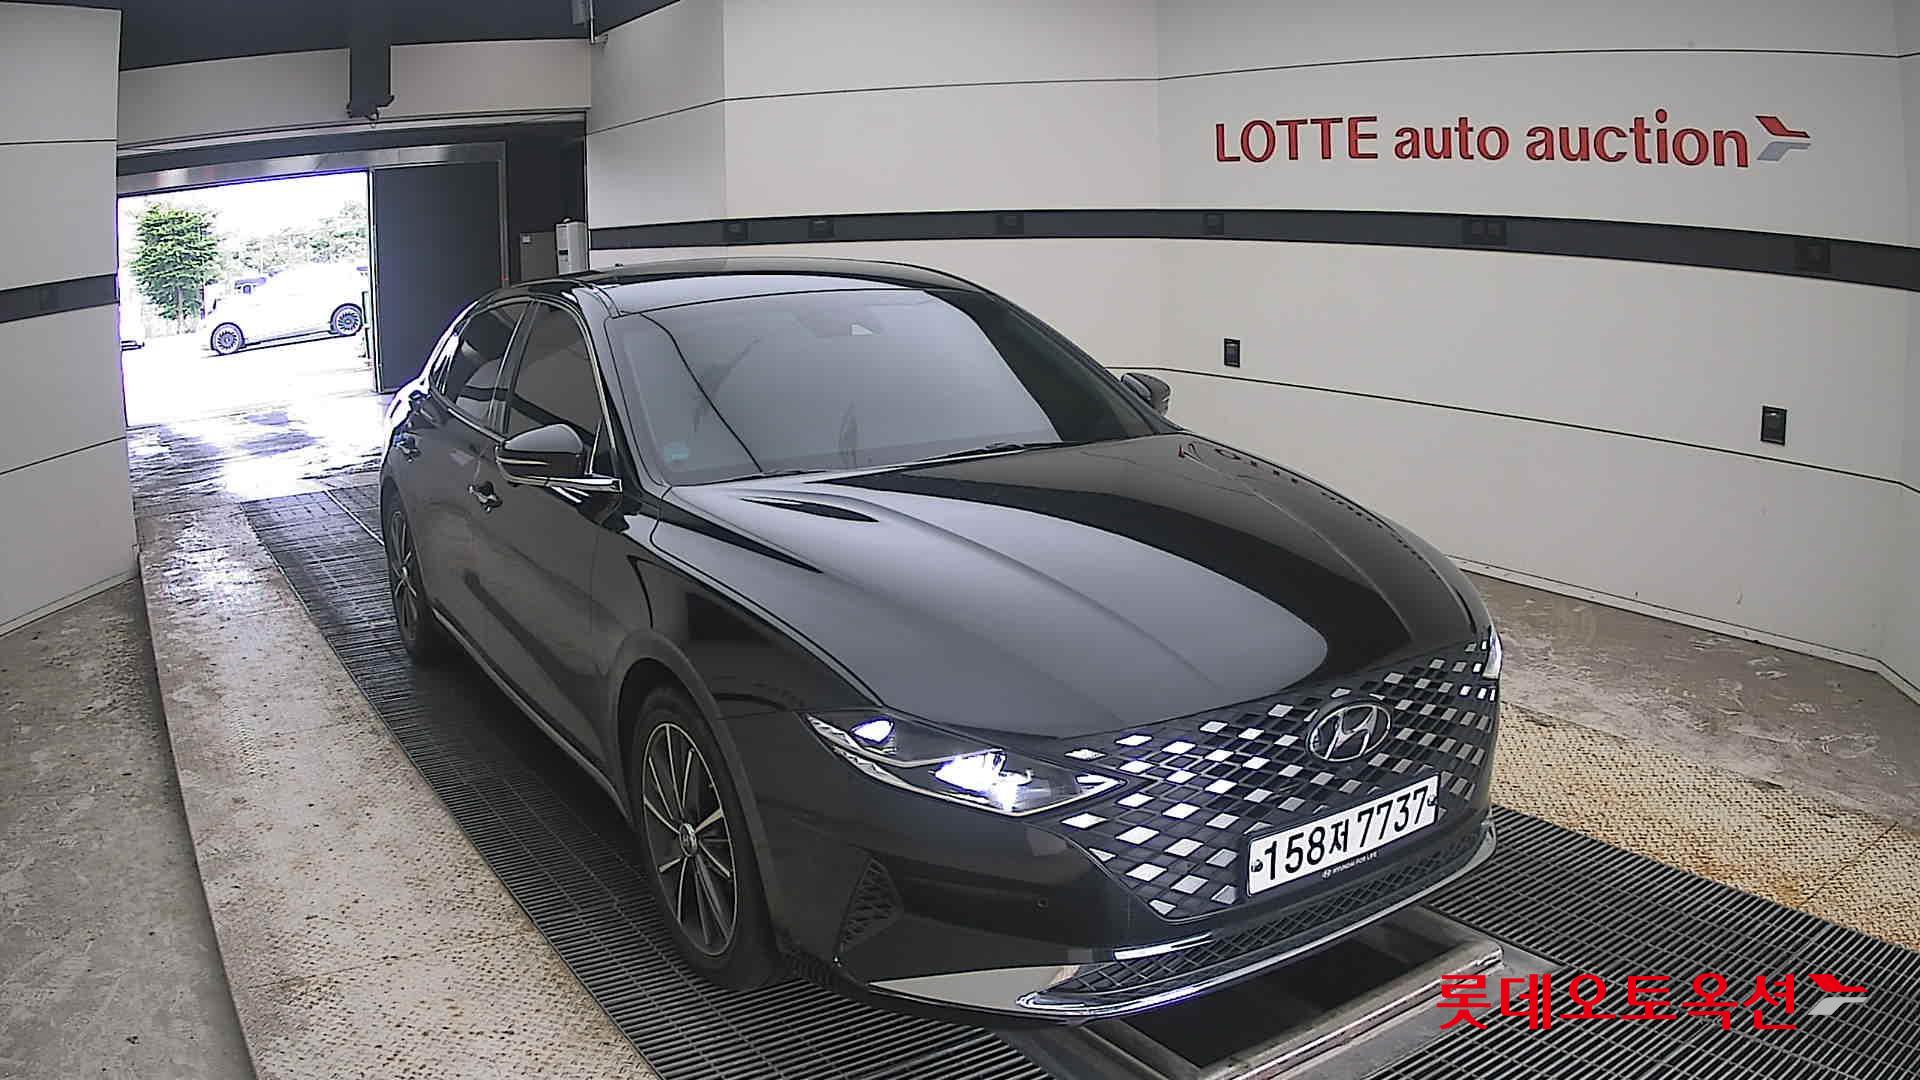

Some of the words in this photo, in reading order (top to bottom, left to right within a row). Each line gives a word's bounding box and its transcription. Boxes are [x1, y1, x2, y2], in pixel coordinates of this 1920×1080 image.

[1216, 116, 1378, 162] LOTTE
[1394, 117, 1510, 161] auto
[1525, 108, 1749, 168] auction
[1357, 785, 1429, 848] 7737
